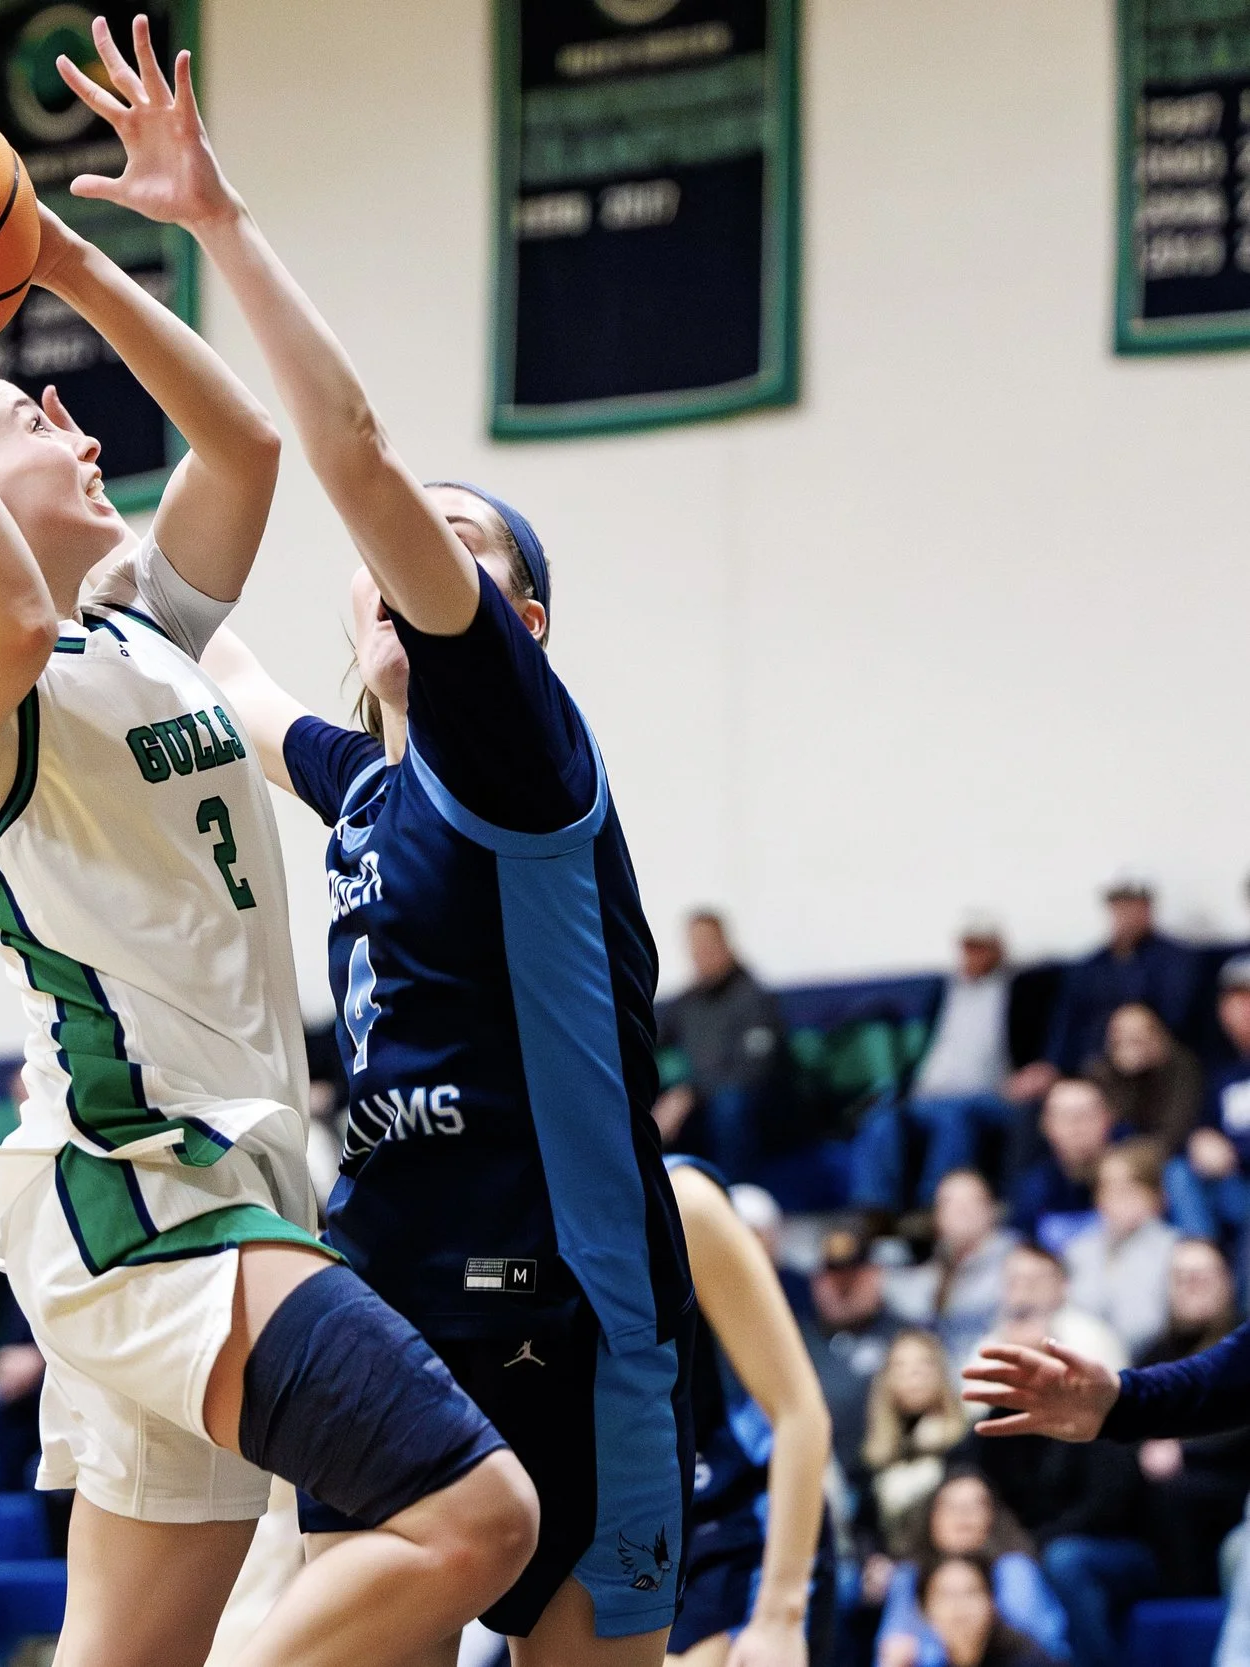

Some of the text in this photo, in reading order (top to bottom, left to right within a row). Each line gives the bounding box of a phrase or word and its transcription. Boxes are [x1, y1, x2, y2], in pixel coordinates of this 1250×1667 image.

[125, 705, 247, 784] GULLS
[195, 795, 258, 911] 2
[344, 934, 382, 1075] 4
[513, 1267, 528, 1285] M
